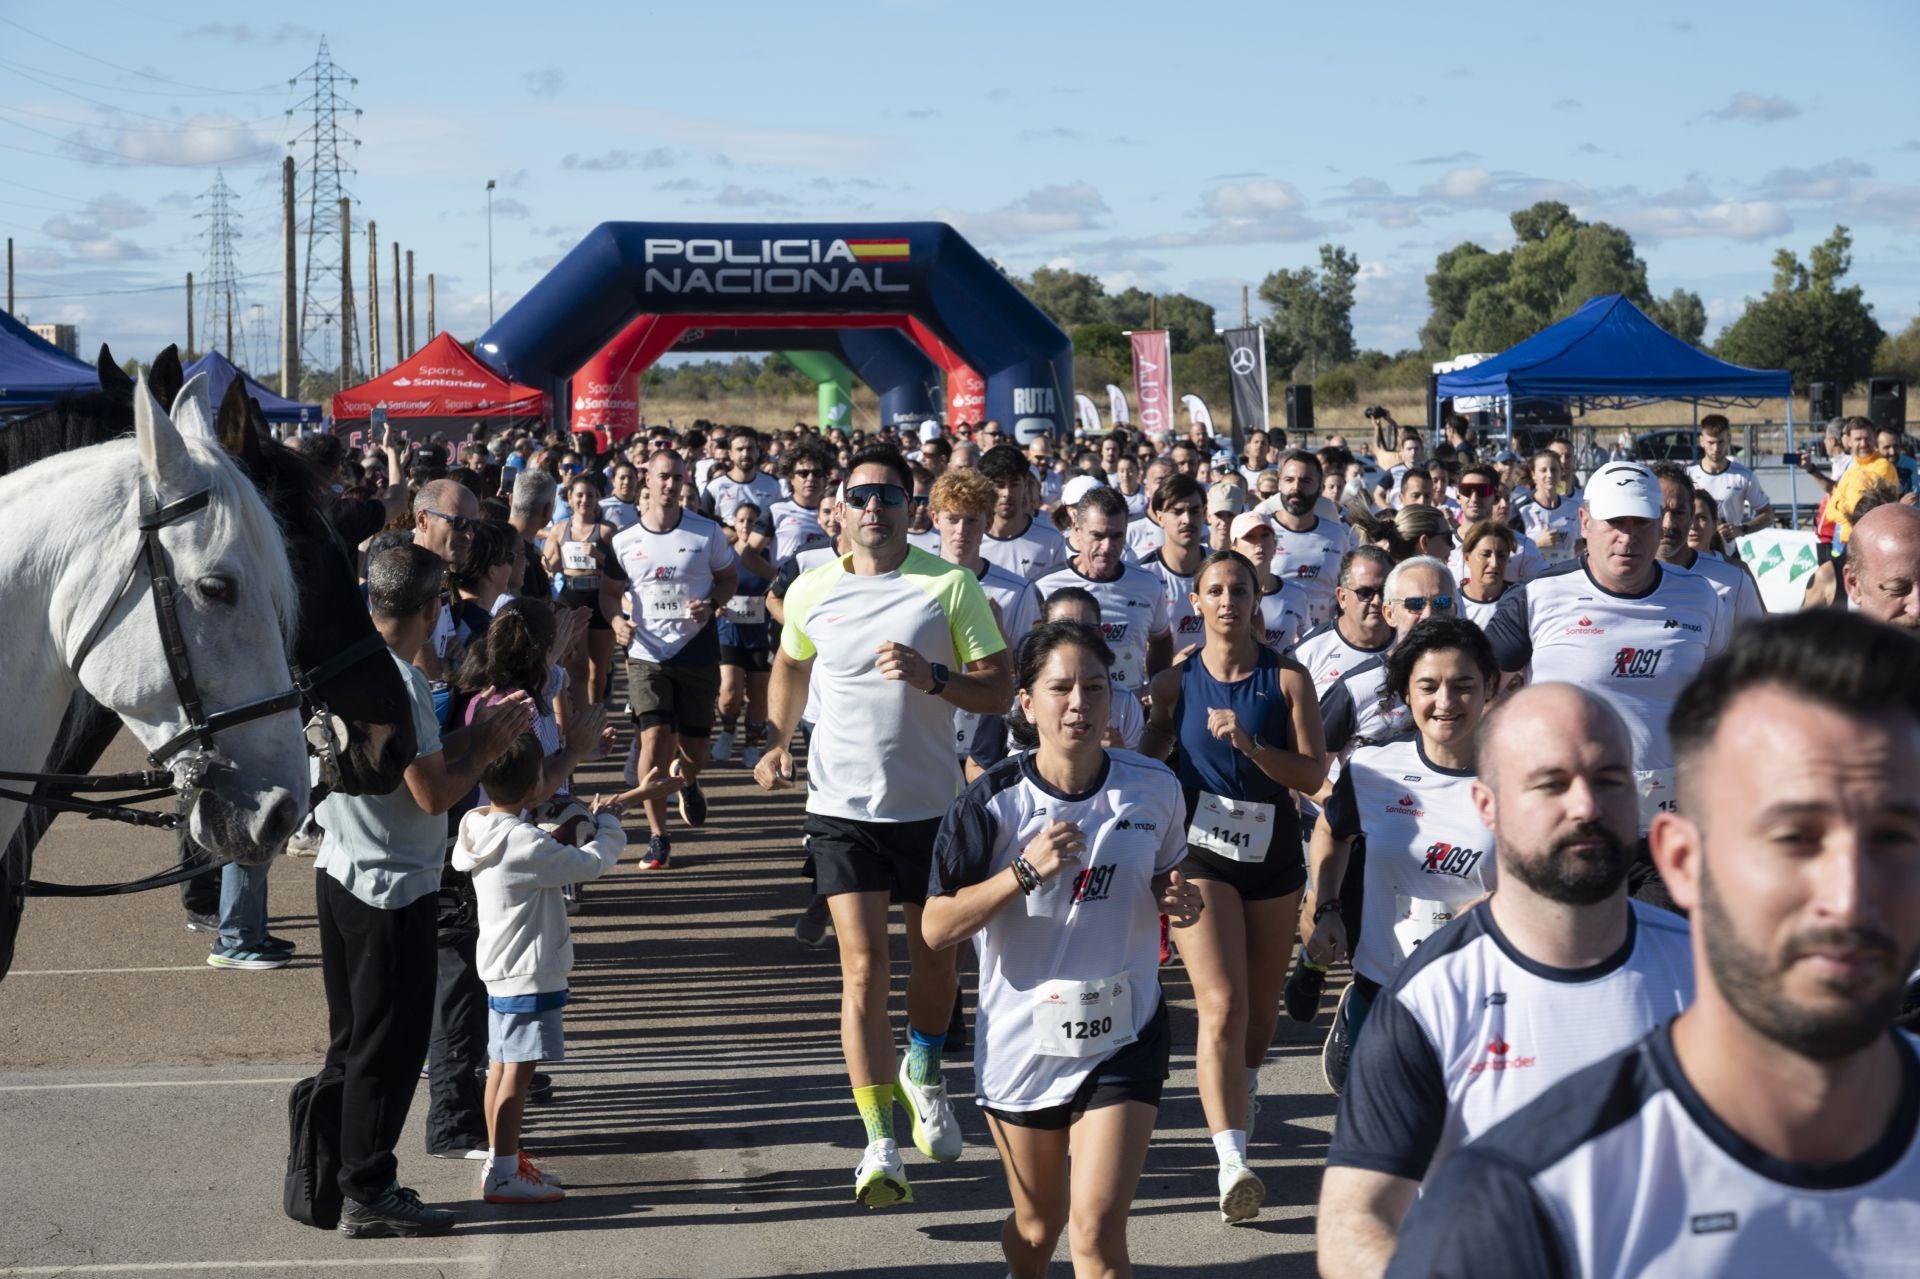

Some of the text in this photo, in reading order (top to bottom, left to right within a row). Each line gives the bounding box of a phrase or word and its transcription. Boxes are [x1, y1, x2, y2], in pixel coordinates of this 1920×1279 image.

[644, 267, 911, 294] NACIONAL
[419, 366, 465, 377] Sports
[413, 378, 488, 389] Santander
[1013, 387, 1056, 415] RUTA
[655, 602, 678, 611] 1415
[1565, 627, 1606, 636] Santander
[1385, 805, 1425, 817] Santander
[1212, 826, 1251, 848] 1141
[1061, 1016, 1113, 1040] 1280
